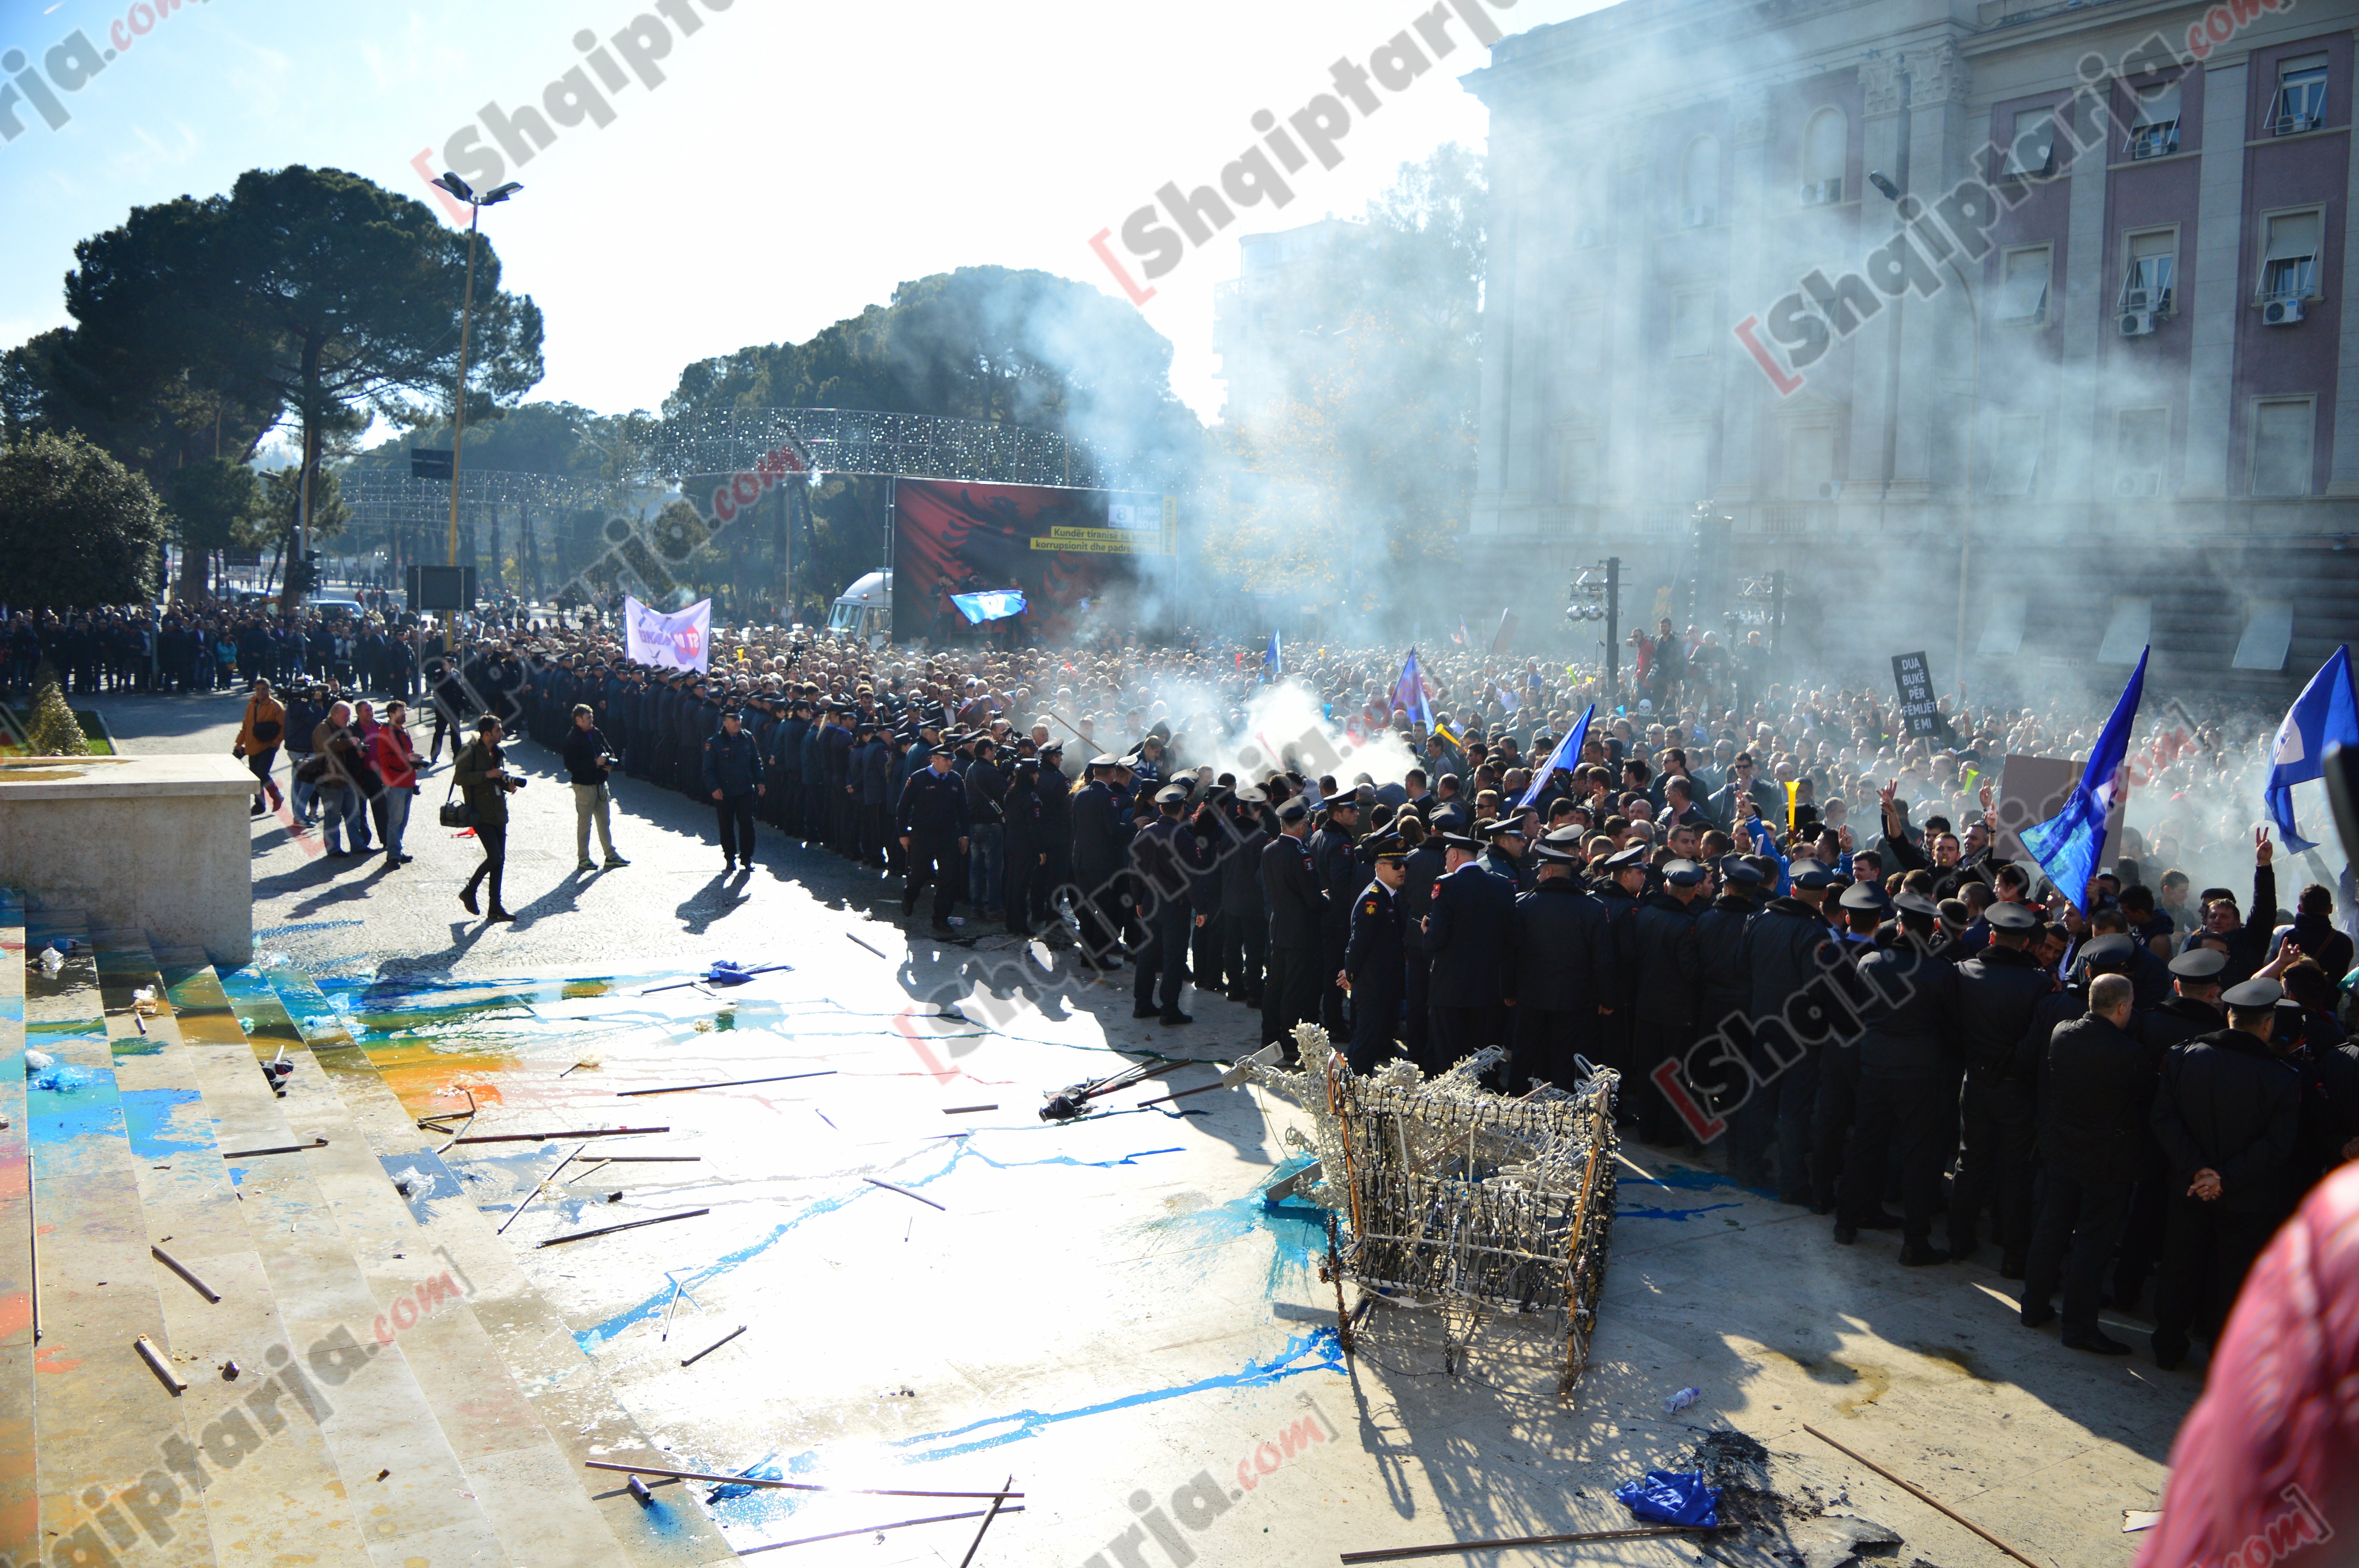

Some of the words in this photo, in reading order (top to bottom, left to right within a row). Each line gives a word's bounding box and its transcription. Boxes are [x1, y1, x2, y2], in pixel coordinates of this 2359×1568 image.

[1116, 506, 1127, 520] 8
[1137, 506, 1160, 515] 1990
[1136, 520, 1160, 529] 2015
[1054, 528, 1085, 537] Kundër
[1087, 529, 1118, 539] tiranisë
[1121, 531, 1129, 539] së
[1132, 532, 1156, 541] krimit
[1036, 540, 1088, 550] korrupsionit
[1090, 542, 1106, 551] dhe
[1901, 657, 1921, 670] DUA
[1902, 670, 1925, 686] BUKË
[1908, 686, 1925, 700] PËR
[1902, 700, 1936, 717] FËMIJËT
[1914, 720, 1920, 730] E
[1921, 718, 1932, 729] MI
